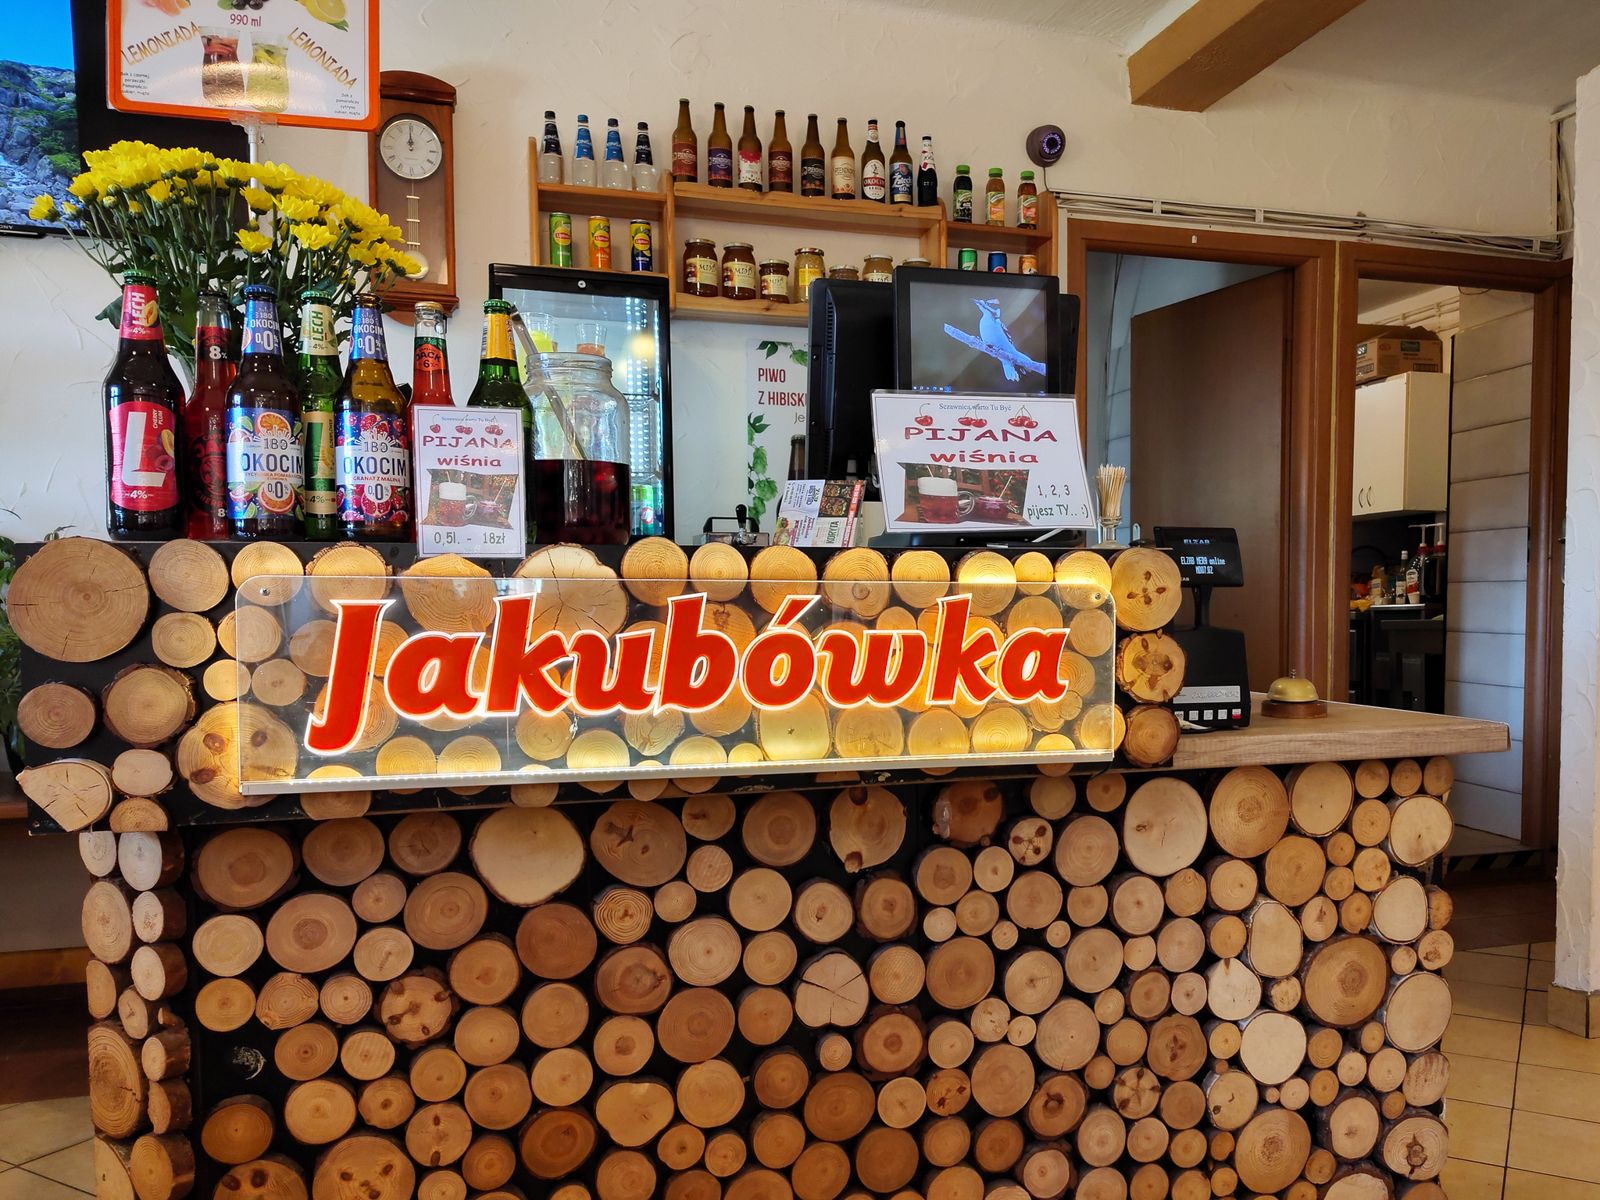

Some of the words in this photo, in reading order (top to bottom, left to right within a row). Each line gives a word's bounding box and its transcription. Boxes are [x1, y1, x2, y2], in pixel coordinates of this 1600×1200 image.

[230, 13, 248, 26] 990
[249, 16, 262, 27] ml
[121, 24, 201, 65] LEMONIADA
[288, 29, 358, 90] LEMONIADA
[131, 292, 145, 326] LECH
[311, 310, 325, 342] LECH
[209, 345, 228, 360] 8%
[416, 351, 441, 363] JACK
[758, 367, 786, 383] PIWO
[758, 391, 765, 405] Z
[991, 403, 999, 411] Tu
[793, 412, 806, 425] Je
[422, 435, 515, 449] PIJANA
[904, 426, 1058, 443] PIJANA
[437, 454, 502, 467] wiśnia
[930, 449, 1039, 464] wiśnia
[343, 456, 407, 477] OKOCIM
[130, 489, 149, 499] 4%
[1065, 484, 1072, 496] 3
[1027, 504, 1055, 520] pijesz
[482, 531, 506, 545] 18zł
[303, 592, 1073, 757] Jakubówka
